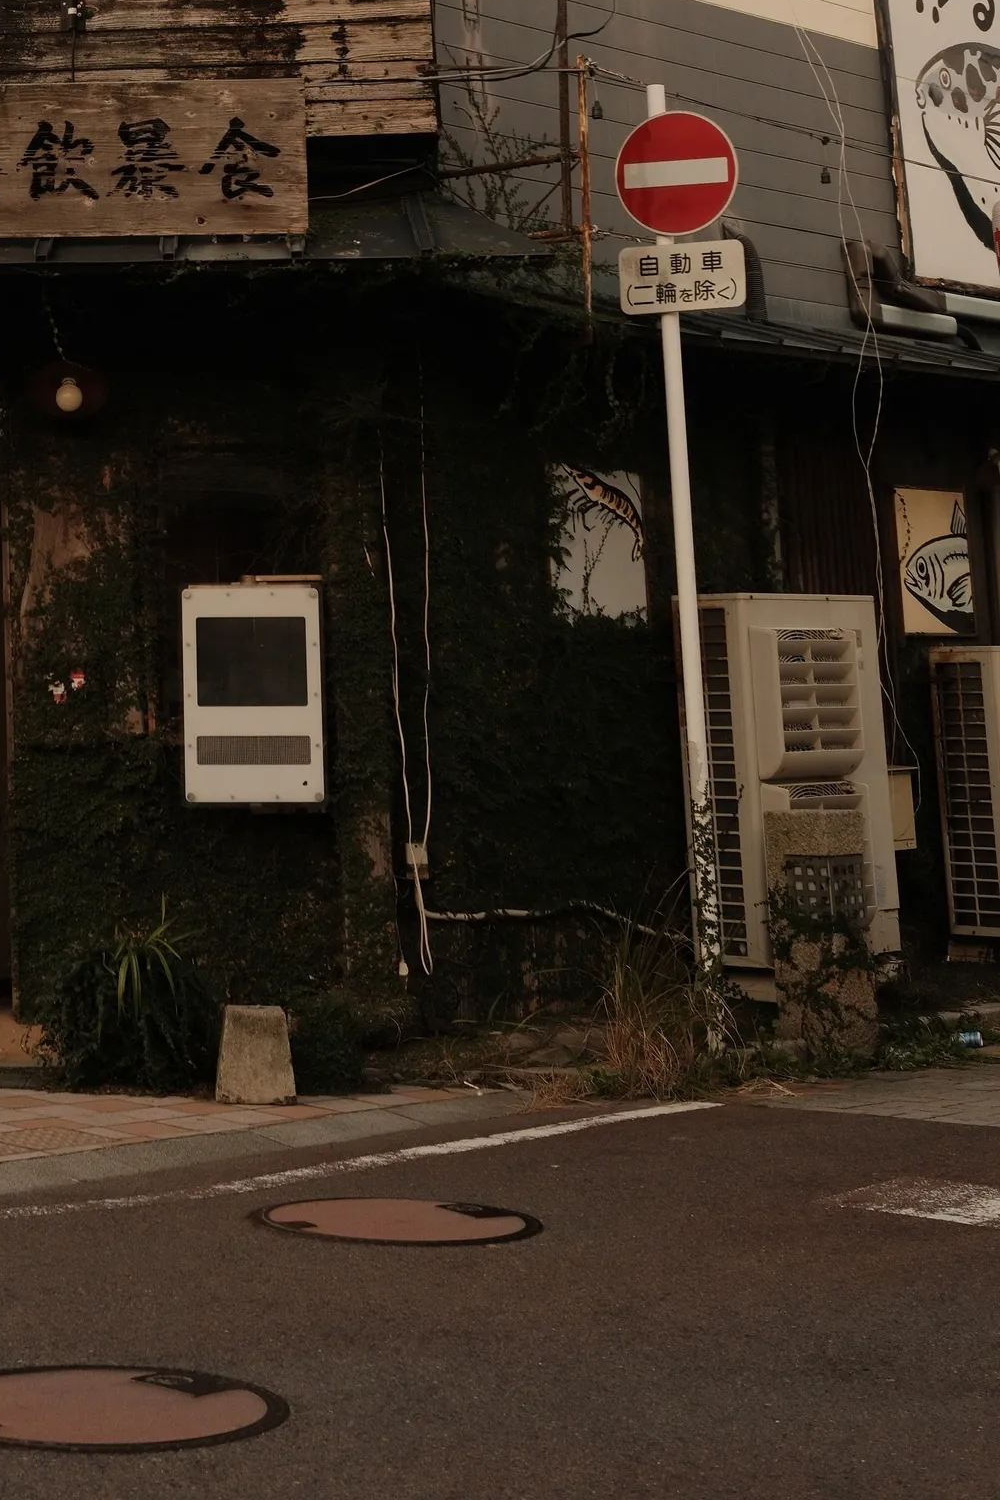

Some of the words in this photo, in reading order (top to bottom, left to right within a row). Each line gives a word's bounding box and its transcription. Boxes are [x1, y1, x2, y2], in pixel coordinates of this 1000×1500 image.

[639, 250, 723, 277] 自動車
[626, 277, 737, 307] (二輪を除く)
